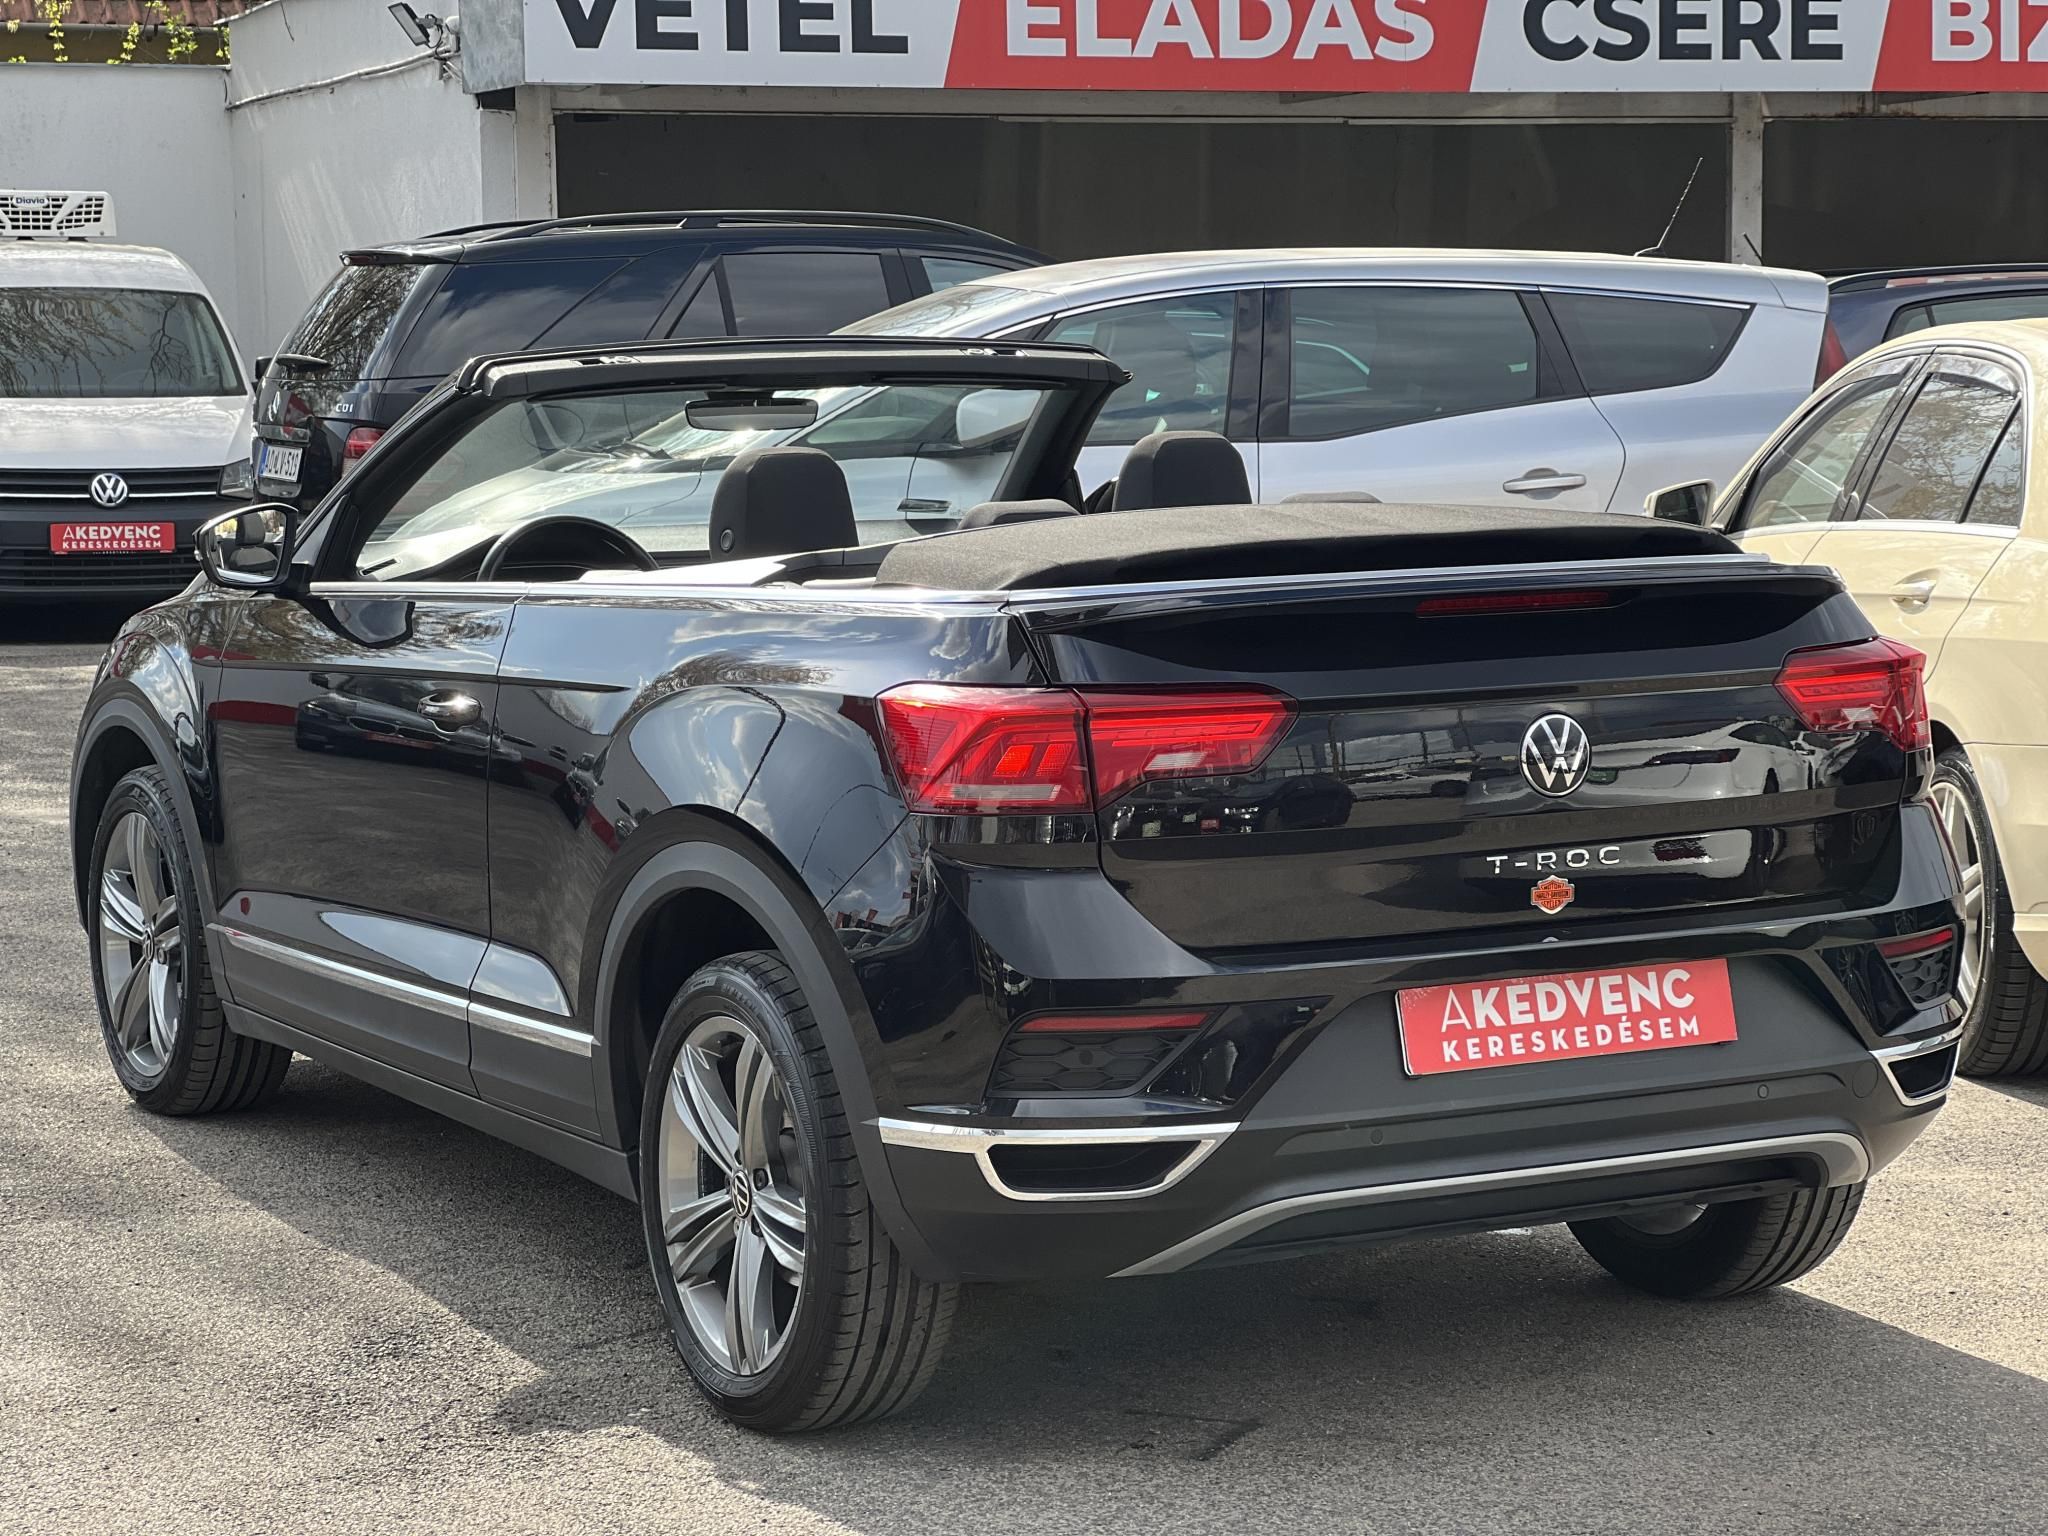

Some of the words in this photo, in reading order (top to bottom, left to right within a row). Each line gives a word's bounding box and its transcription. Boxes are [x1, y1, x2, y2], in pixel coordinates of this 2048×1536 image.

[1522, 0, 1844, 61] CSERE
[15, 196, 45, 204] Diavia
[335, 403, 354, 413] CDI
[62, 538, 161, 549] KERESKEDÉSEM
[1486, 846, 1621, 875] T-ROC
[1441, 1015, 1700, 1063] KERESKEDÉSEM
